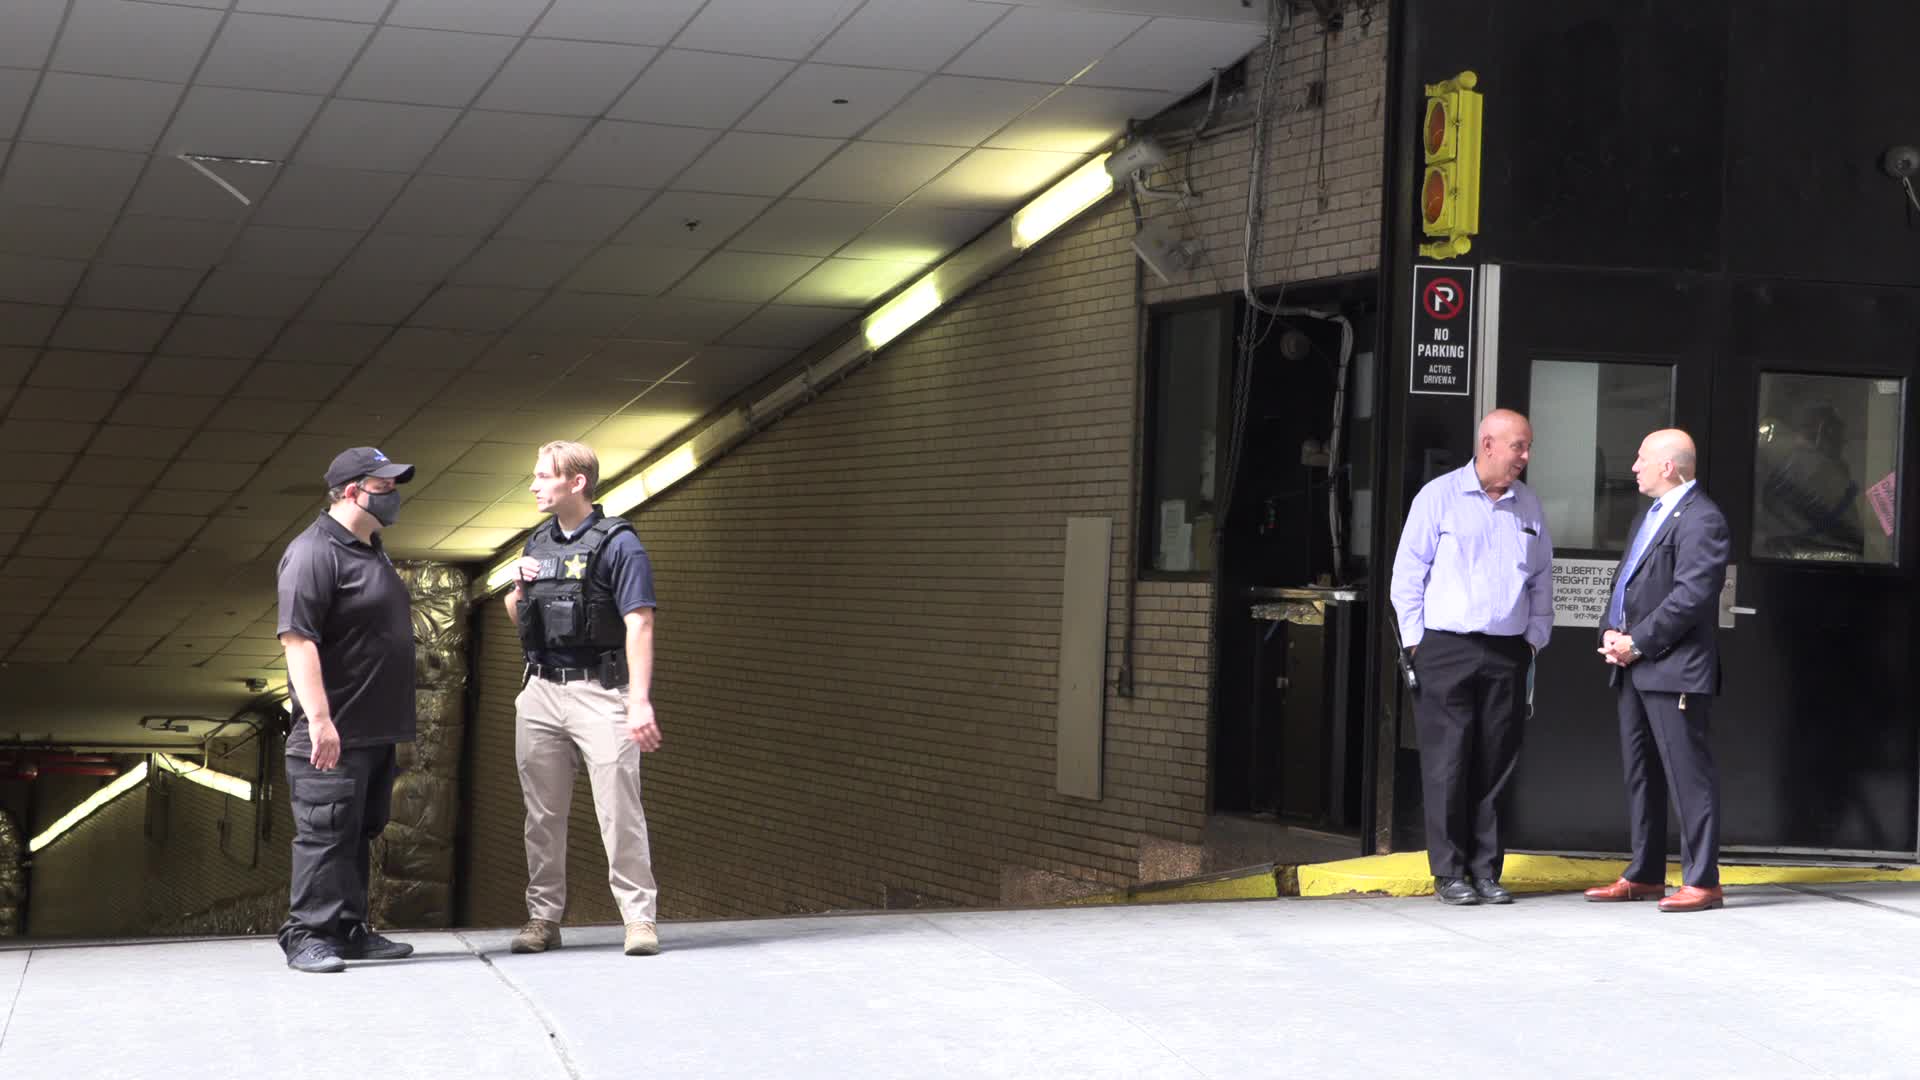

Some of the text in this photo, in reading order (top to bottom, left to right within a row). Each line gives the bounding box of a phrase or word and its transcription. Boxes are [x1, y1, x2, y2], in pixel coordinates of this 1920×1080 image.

[1434, 328, 1449, 341] NO
[1417, 344, 1465, 359] PARKING
[1429, 364, 1452, 375] ACTIVE
[1423, 375, 1456, 385] DRIVEWAY
[1552, 566, 1563, 574] 28
[1566, 566, 1603, 575] LIBERTY
[1552, 575, 1589, 584] FREIGHT
